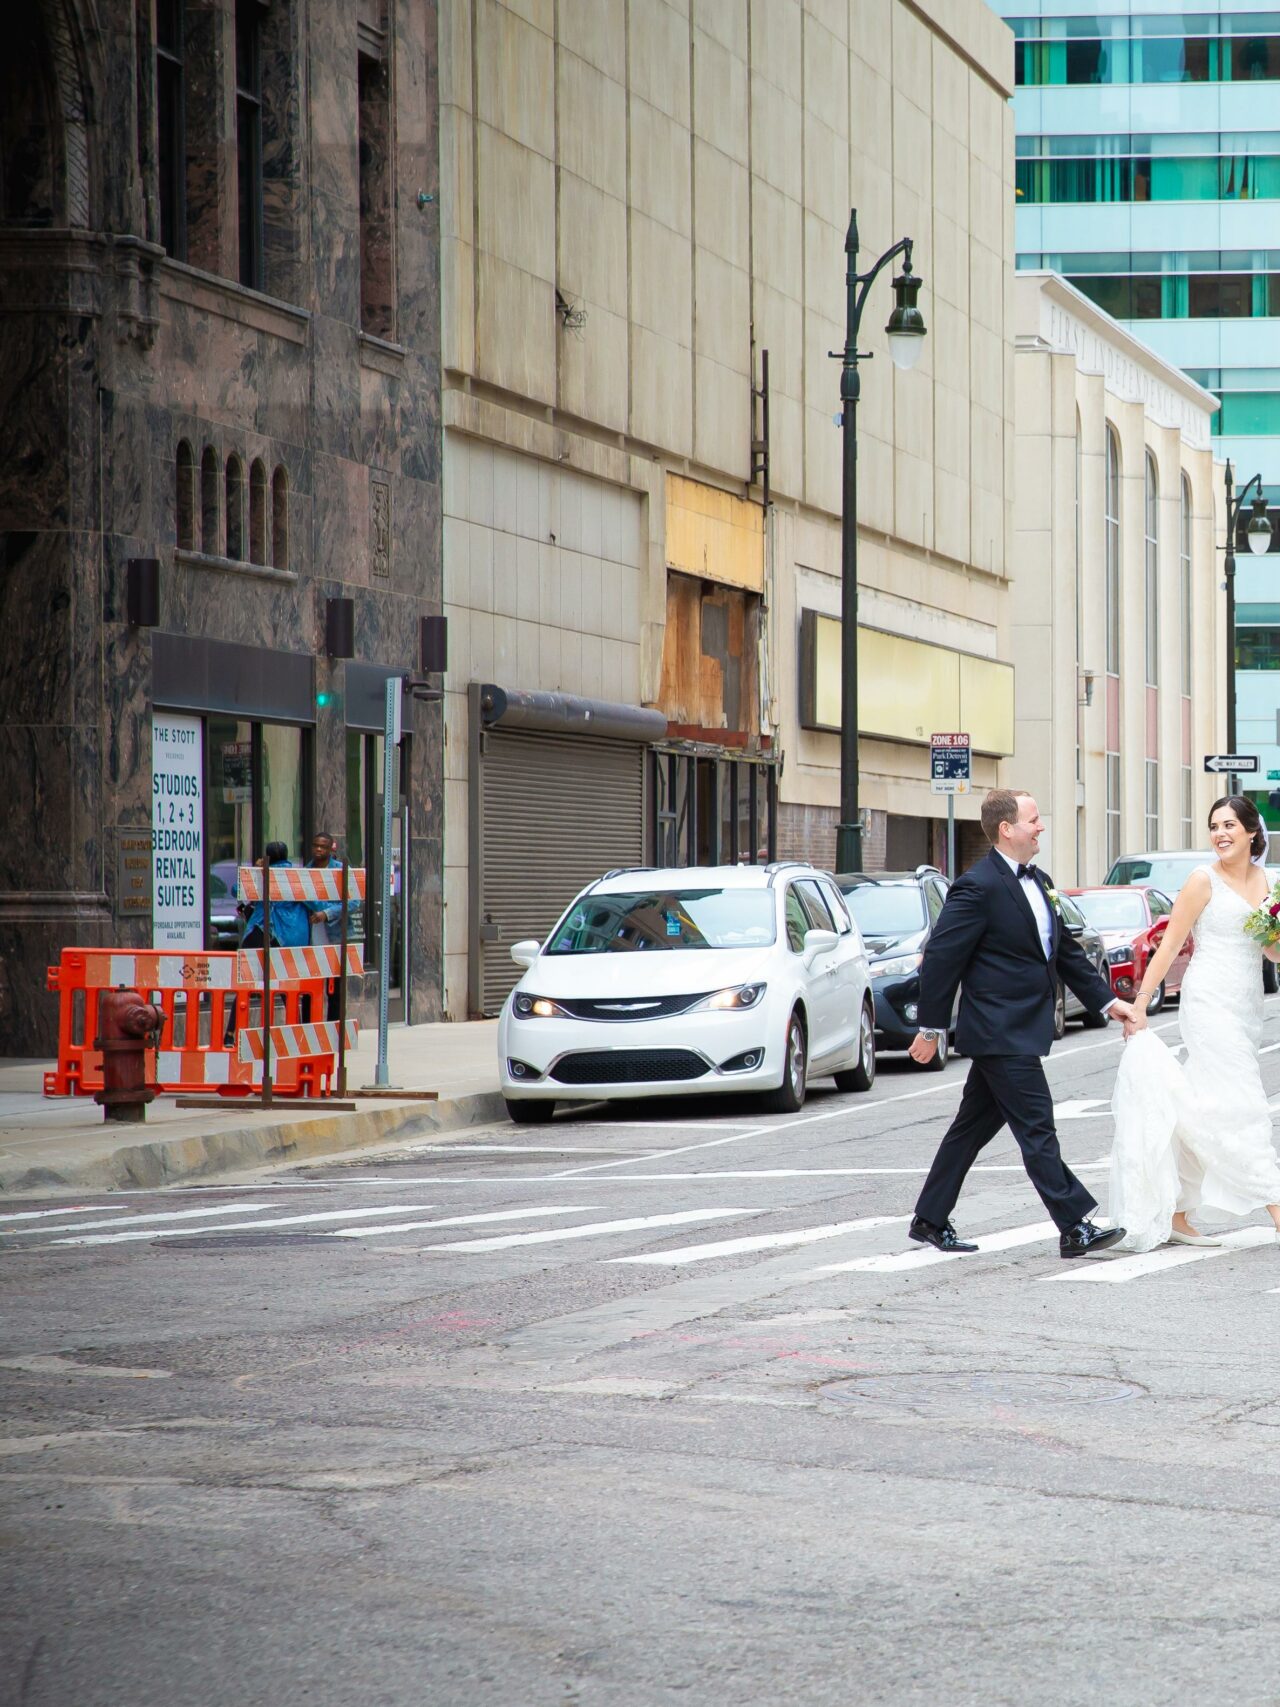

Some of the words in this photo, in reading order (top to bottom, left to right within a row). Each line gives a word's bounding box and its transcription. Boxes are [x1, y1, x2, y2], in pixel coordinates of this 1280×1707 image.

[154, 728, 168, 742] THE
[172, 729, 196, 744] STOTT
[932, 735, 952, 746] ZONE
[953, 735, 969, 746] 106
[153, 773, 200, 798] STUDIOS,
[157, 801, 165, 825] 1,
[169, 802, 175, 823] 2
[179, 808, 184, 822] +
[188, 803, 194, 824] 3
[152, 830, 200, 851] BEDROOM
[156, 858, 196, 879] RENTAL
[157, 886, 195, 907] SUITES
